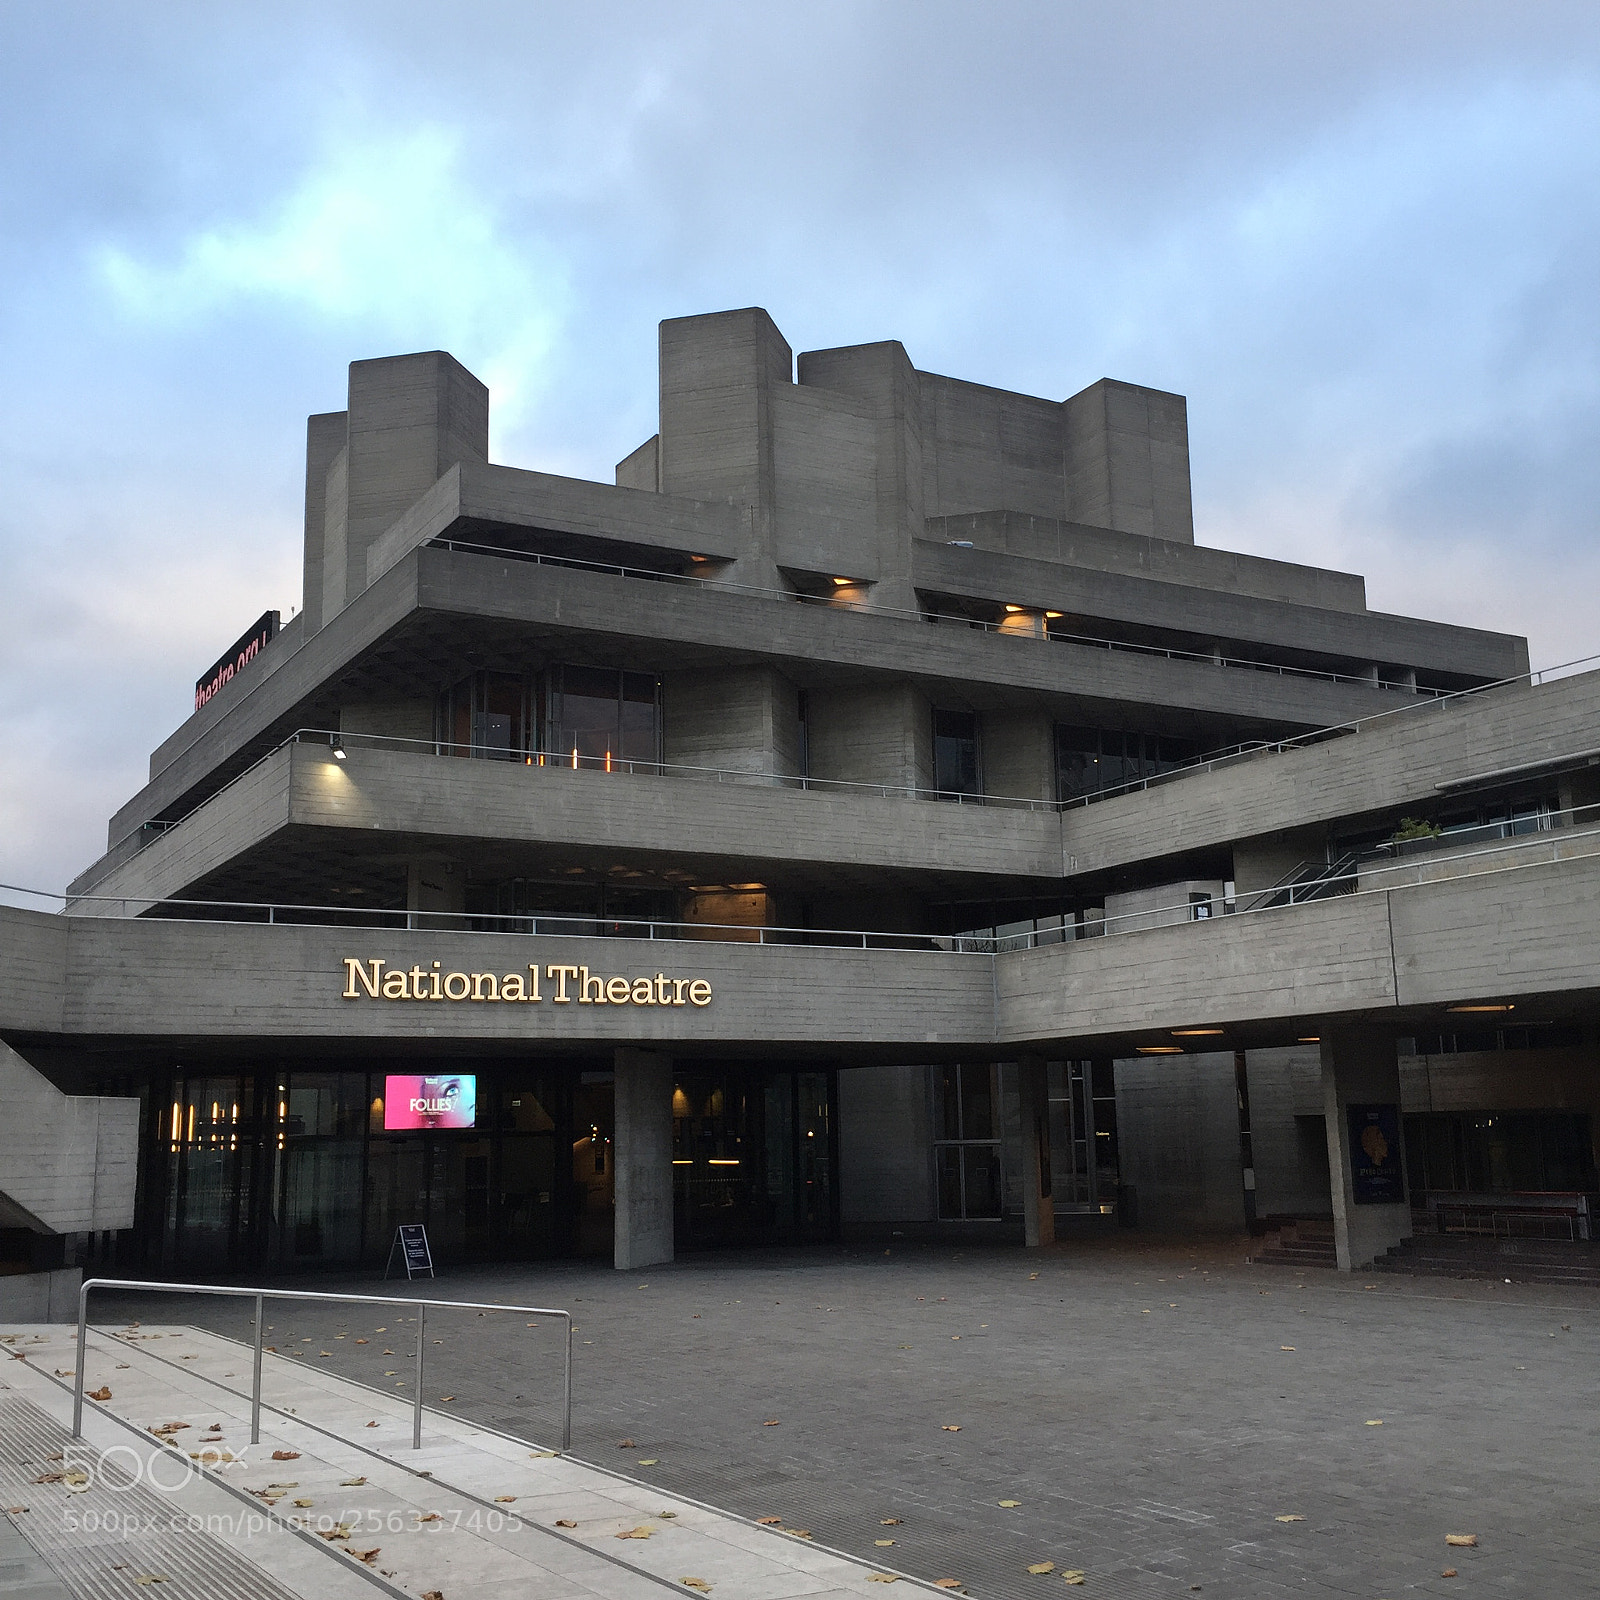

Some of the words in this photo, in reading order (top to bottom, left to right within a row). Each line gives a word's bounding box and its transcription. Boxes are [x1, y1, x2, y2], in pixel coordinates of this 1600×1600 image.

[342, 957, 542, 1002] National
[547, 964, 713, 1006] Theatre
[409, 1098, 452, 1112] FOLLIES
